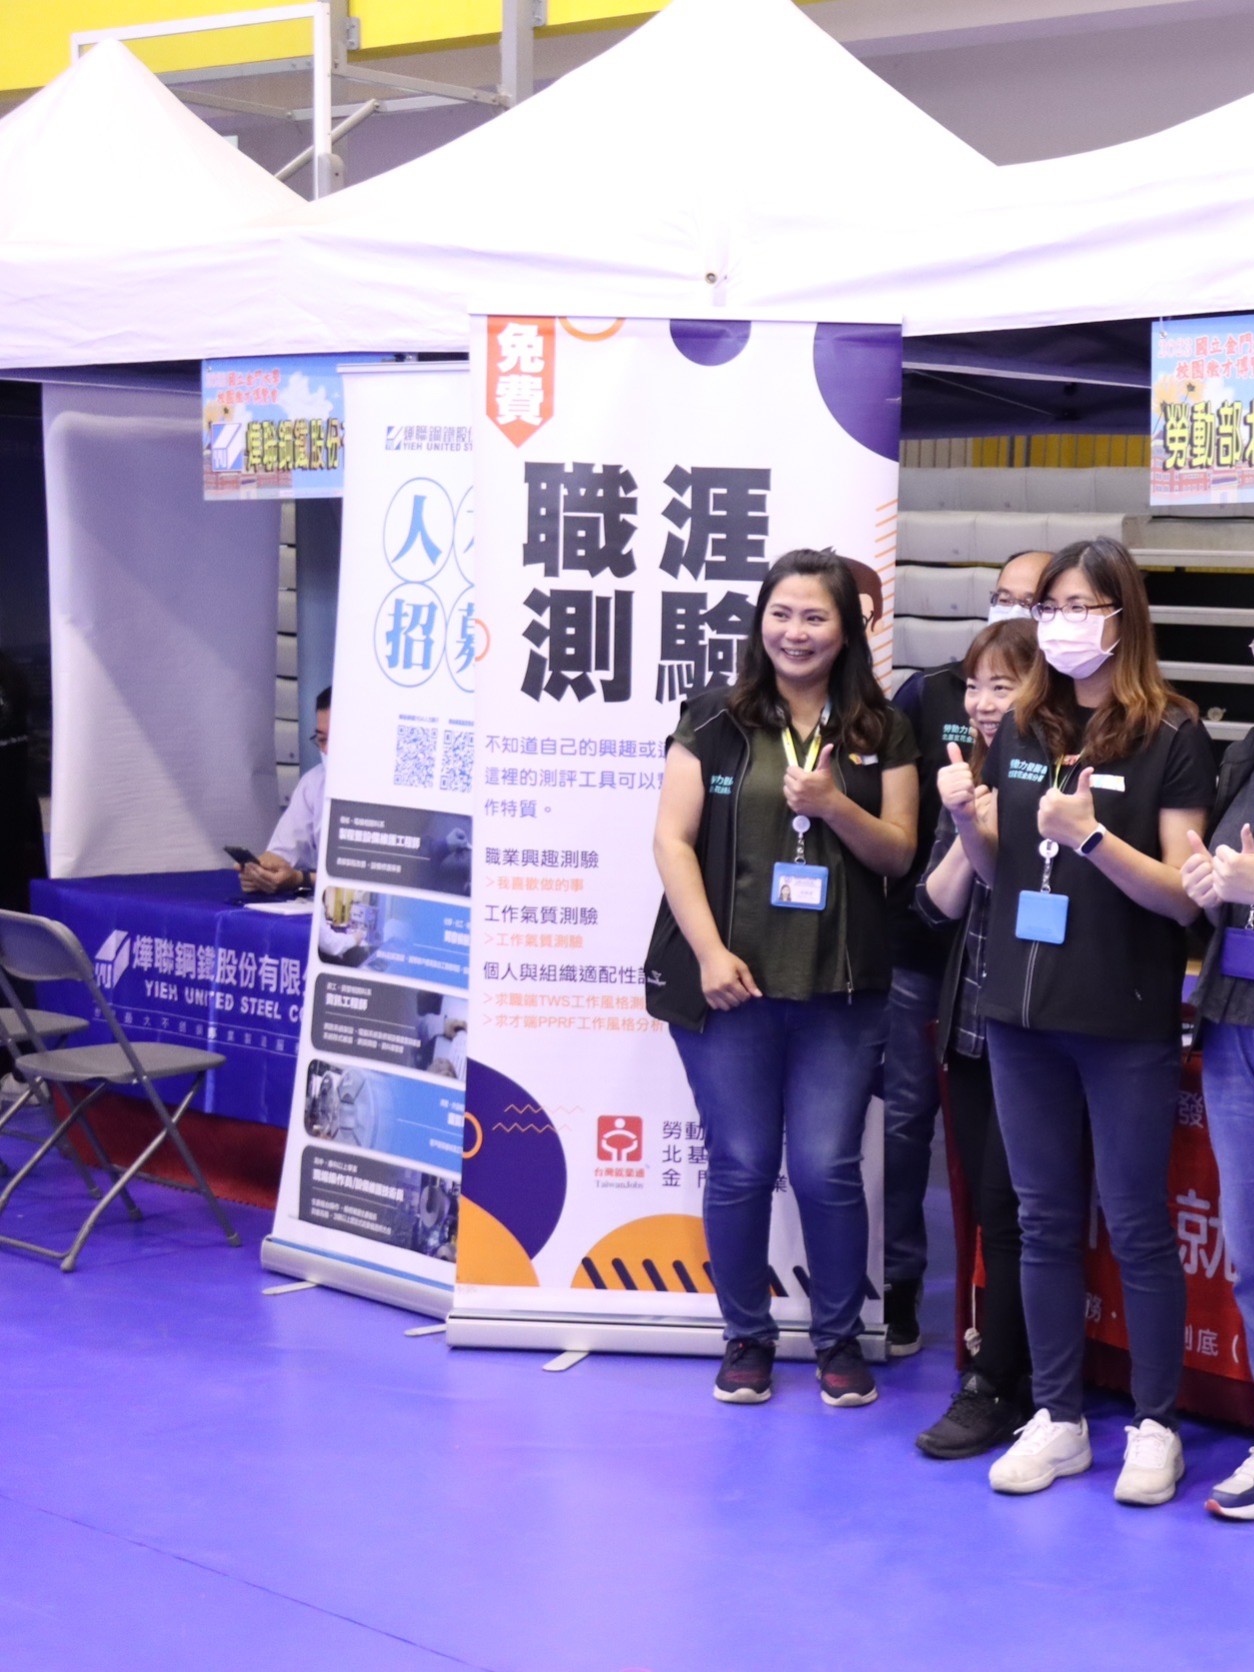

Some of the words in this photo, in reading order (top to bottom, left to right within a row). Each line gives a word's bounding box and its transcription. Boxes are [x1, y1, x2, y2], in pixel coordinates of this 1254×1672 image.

[496, 322, 546, 426] 免費
[522, 462, 772, 582] 職涯
[520, 588, 760, 704] 測驗
[484, 847, 600, 870] 職業興趣測驗
[484, 904, 599, 926] 工作氣質測驗
[132, 935, 308, 997] 燁聯鋼鐵股份有限
[144, 979, 179, 1002] YIEH
[184, 986, 235, 1012] UNITED
[240, 996, 283, 1020] STEEL
